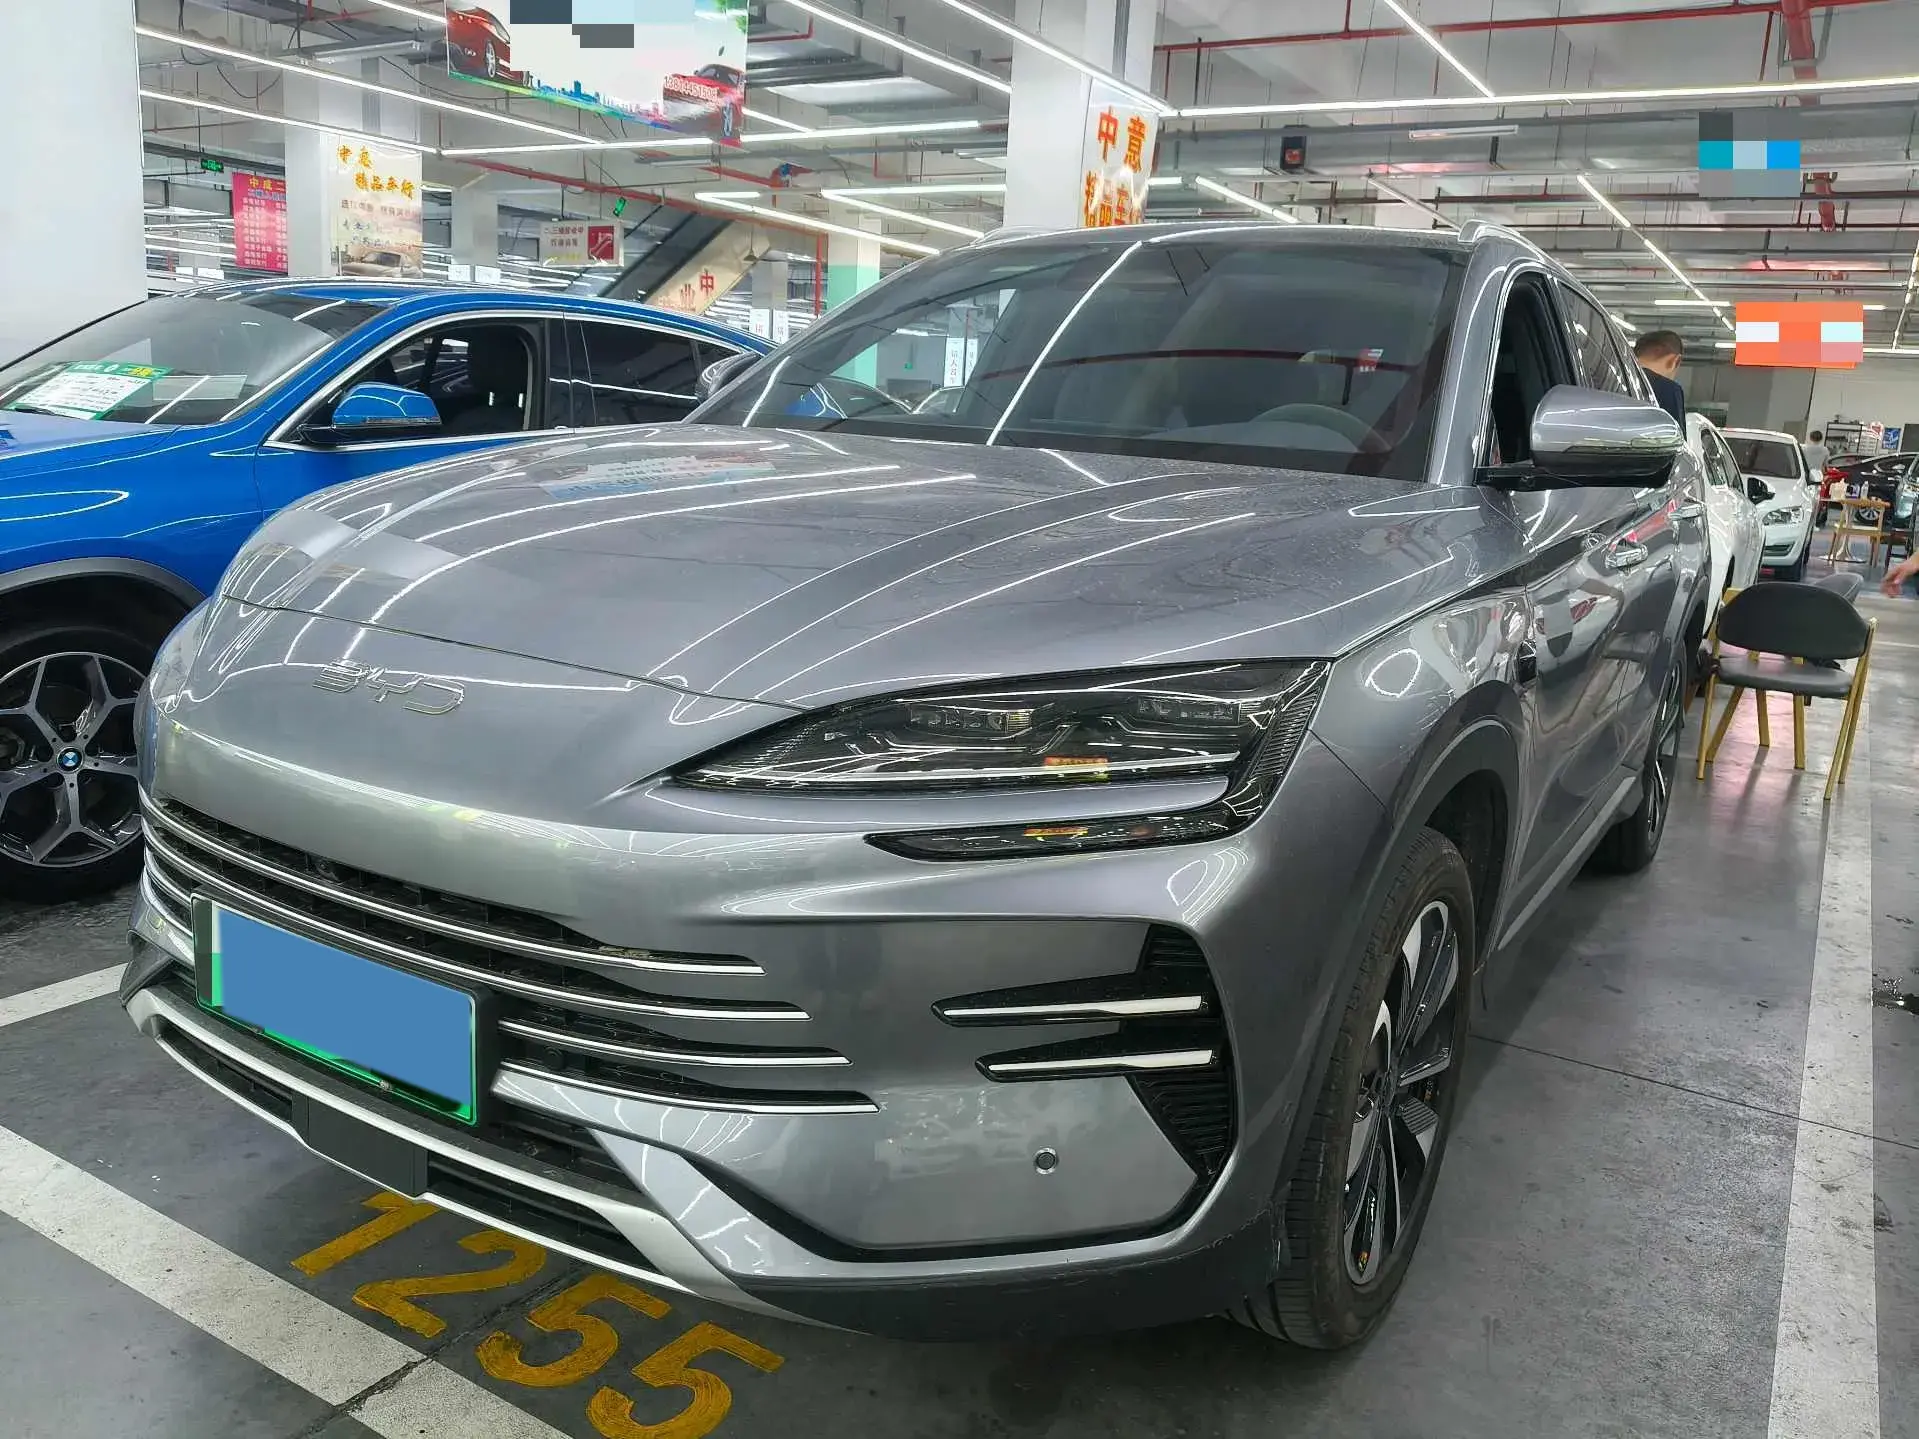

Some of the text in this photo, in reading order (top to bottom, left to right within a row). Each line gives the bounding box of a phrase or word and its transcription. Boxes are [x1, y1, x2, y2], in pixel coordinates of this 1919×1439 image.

[1097, 106, 1146, 173] 中意
[312, 658, 466, 715] BYD
[289, 1190, 785, 1439] 1255
